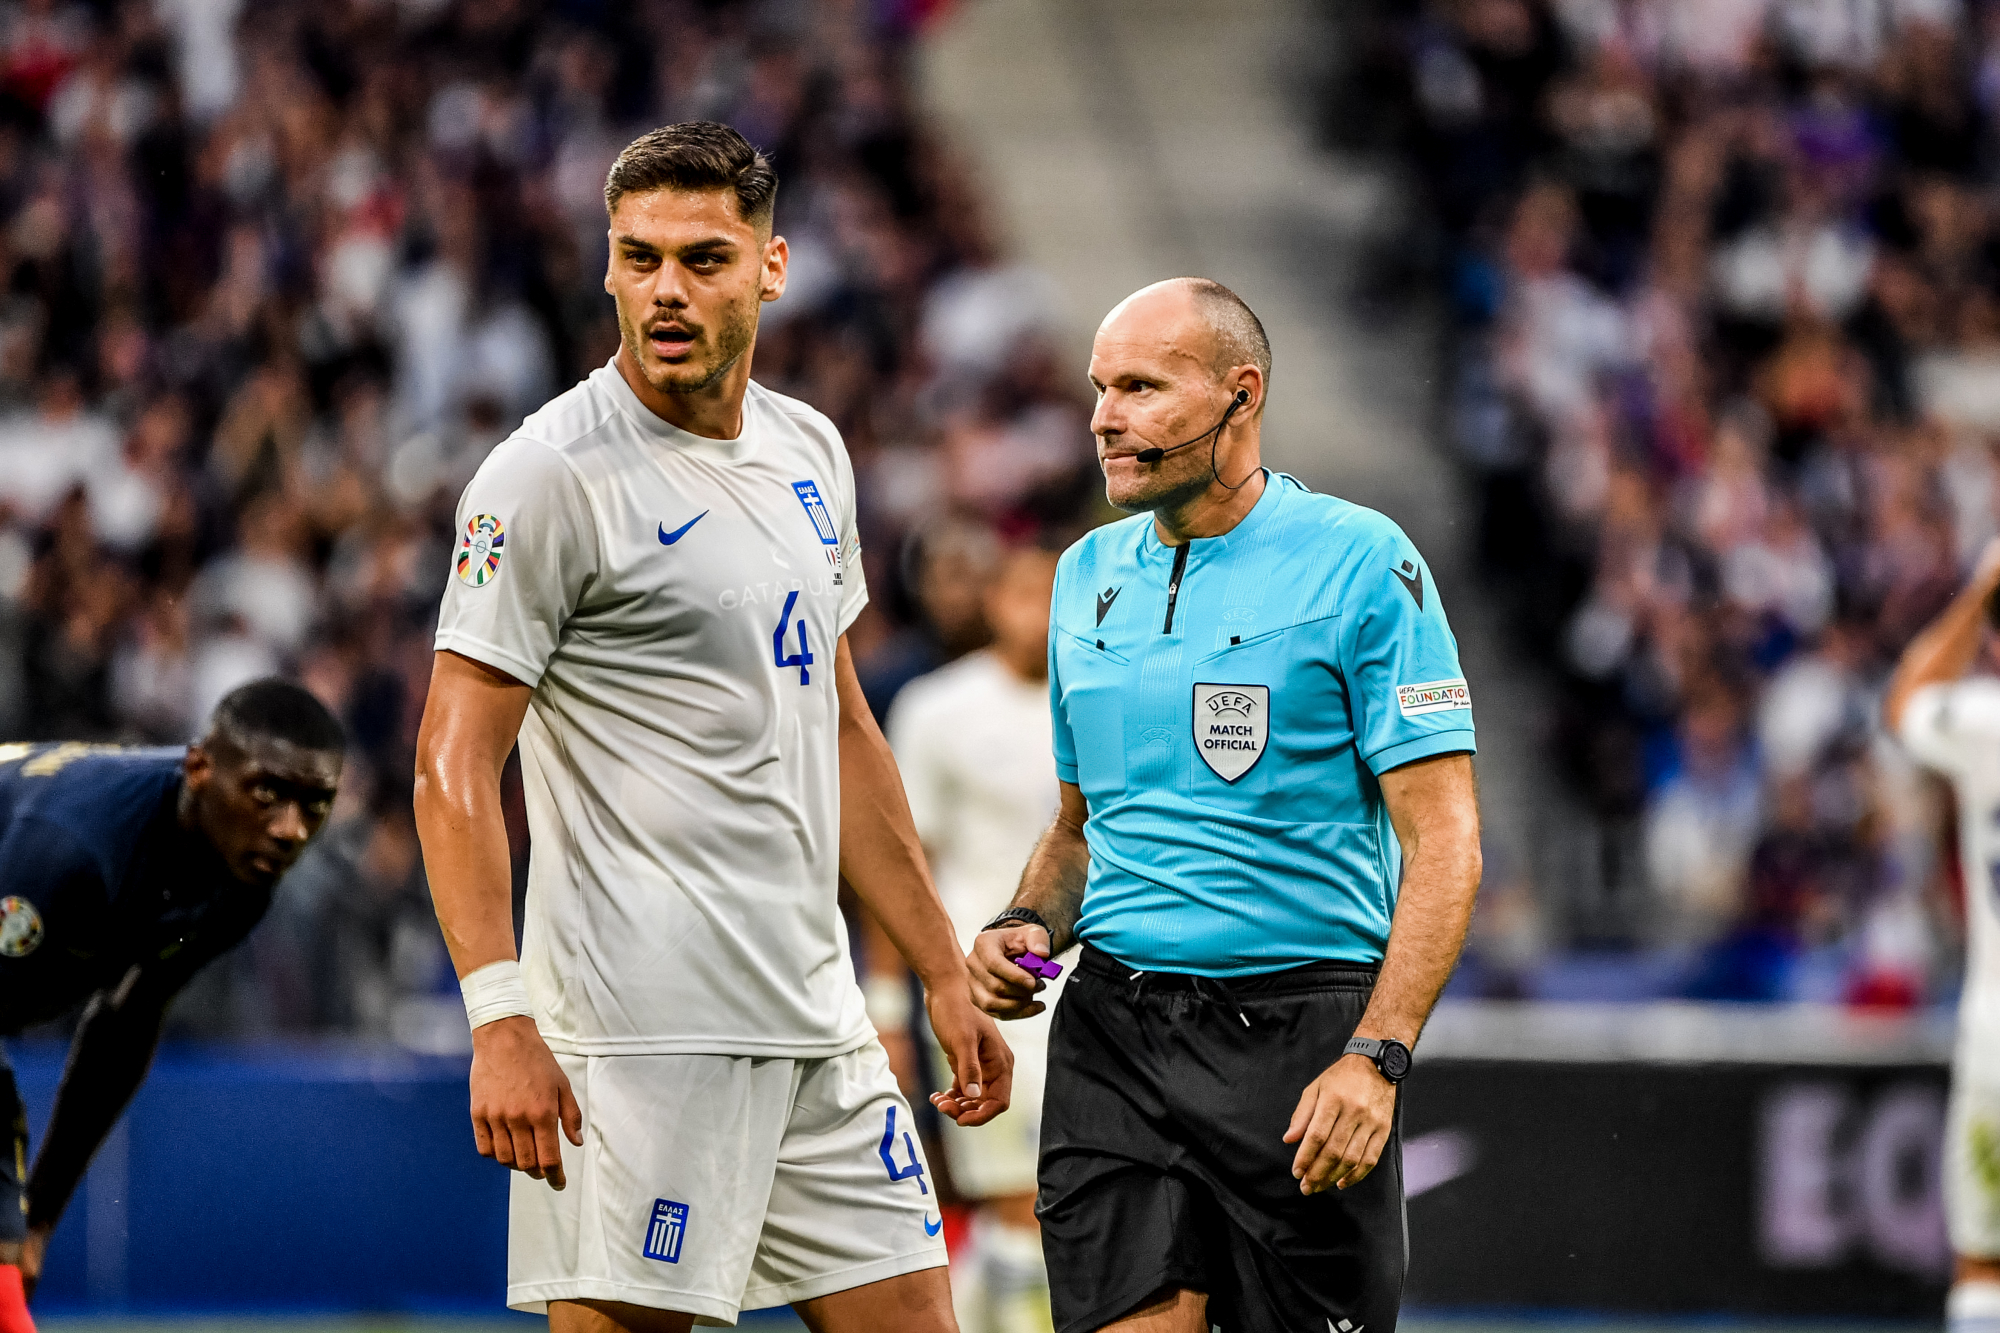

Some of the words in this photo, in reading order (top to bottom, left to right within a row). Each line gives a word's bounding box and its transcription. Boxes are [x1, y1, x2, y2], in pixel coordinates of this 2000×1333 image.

[773, 590, 814, 686] 4
[1399, 686, 1415, 695] UEFA
[1208, 695, 1252, 714] UEFA
[1209, 724, 1253, 736] MATCH
[1203, 738, 1258, 751] OFFICIAL
[879, 1105, 928, 1195] 4
[658, 1203, 684, 1215] ΕΛΛΑΣ
